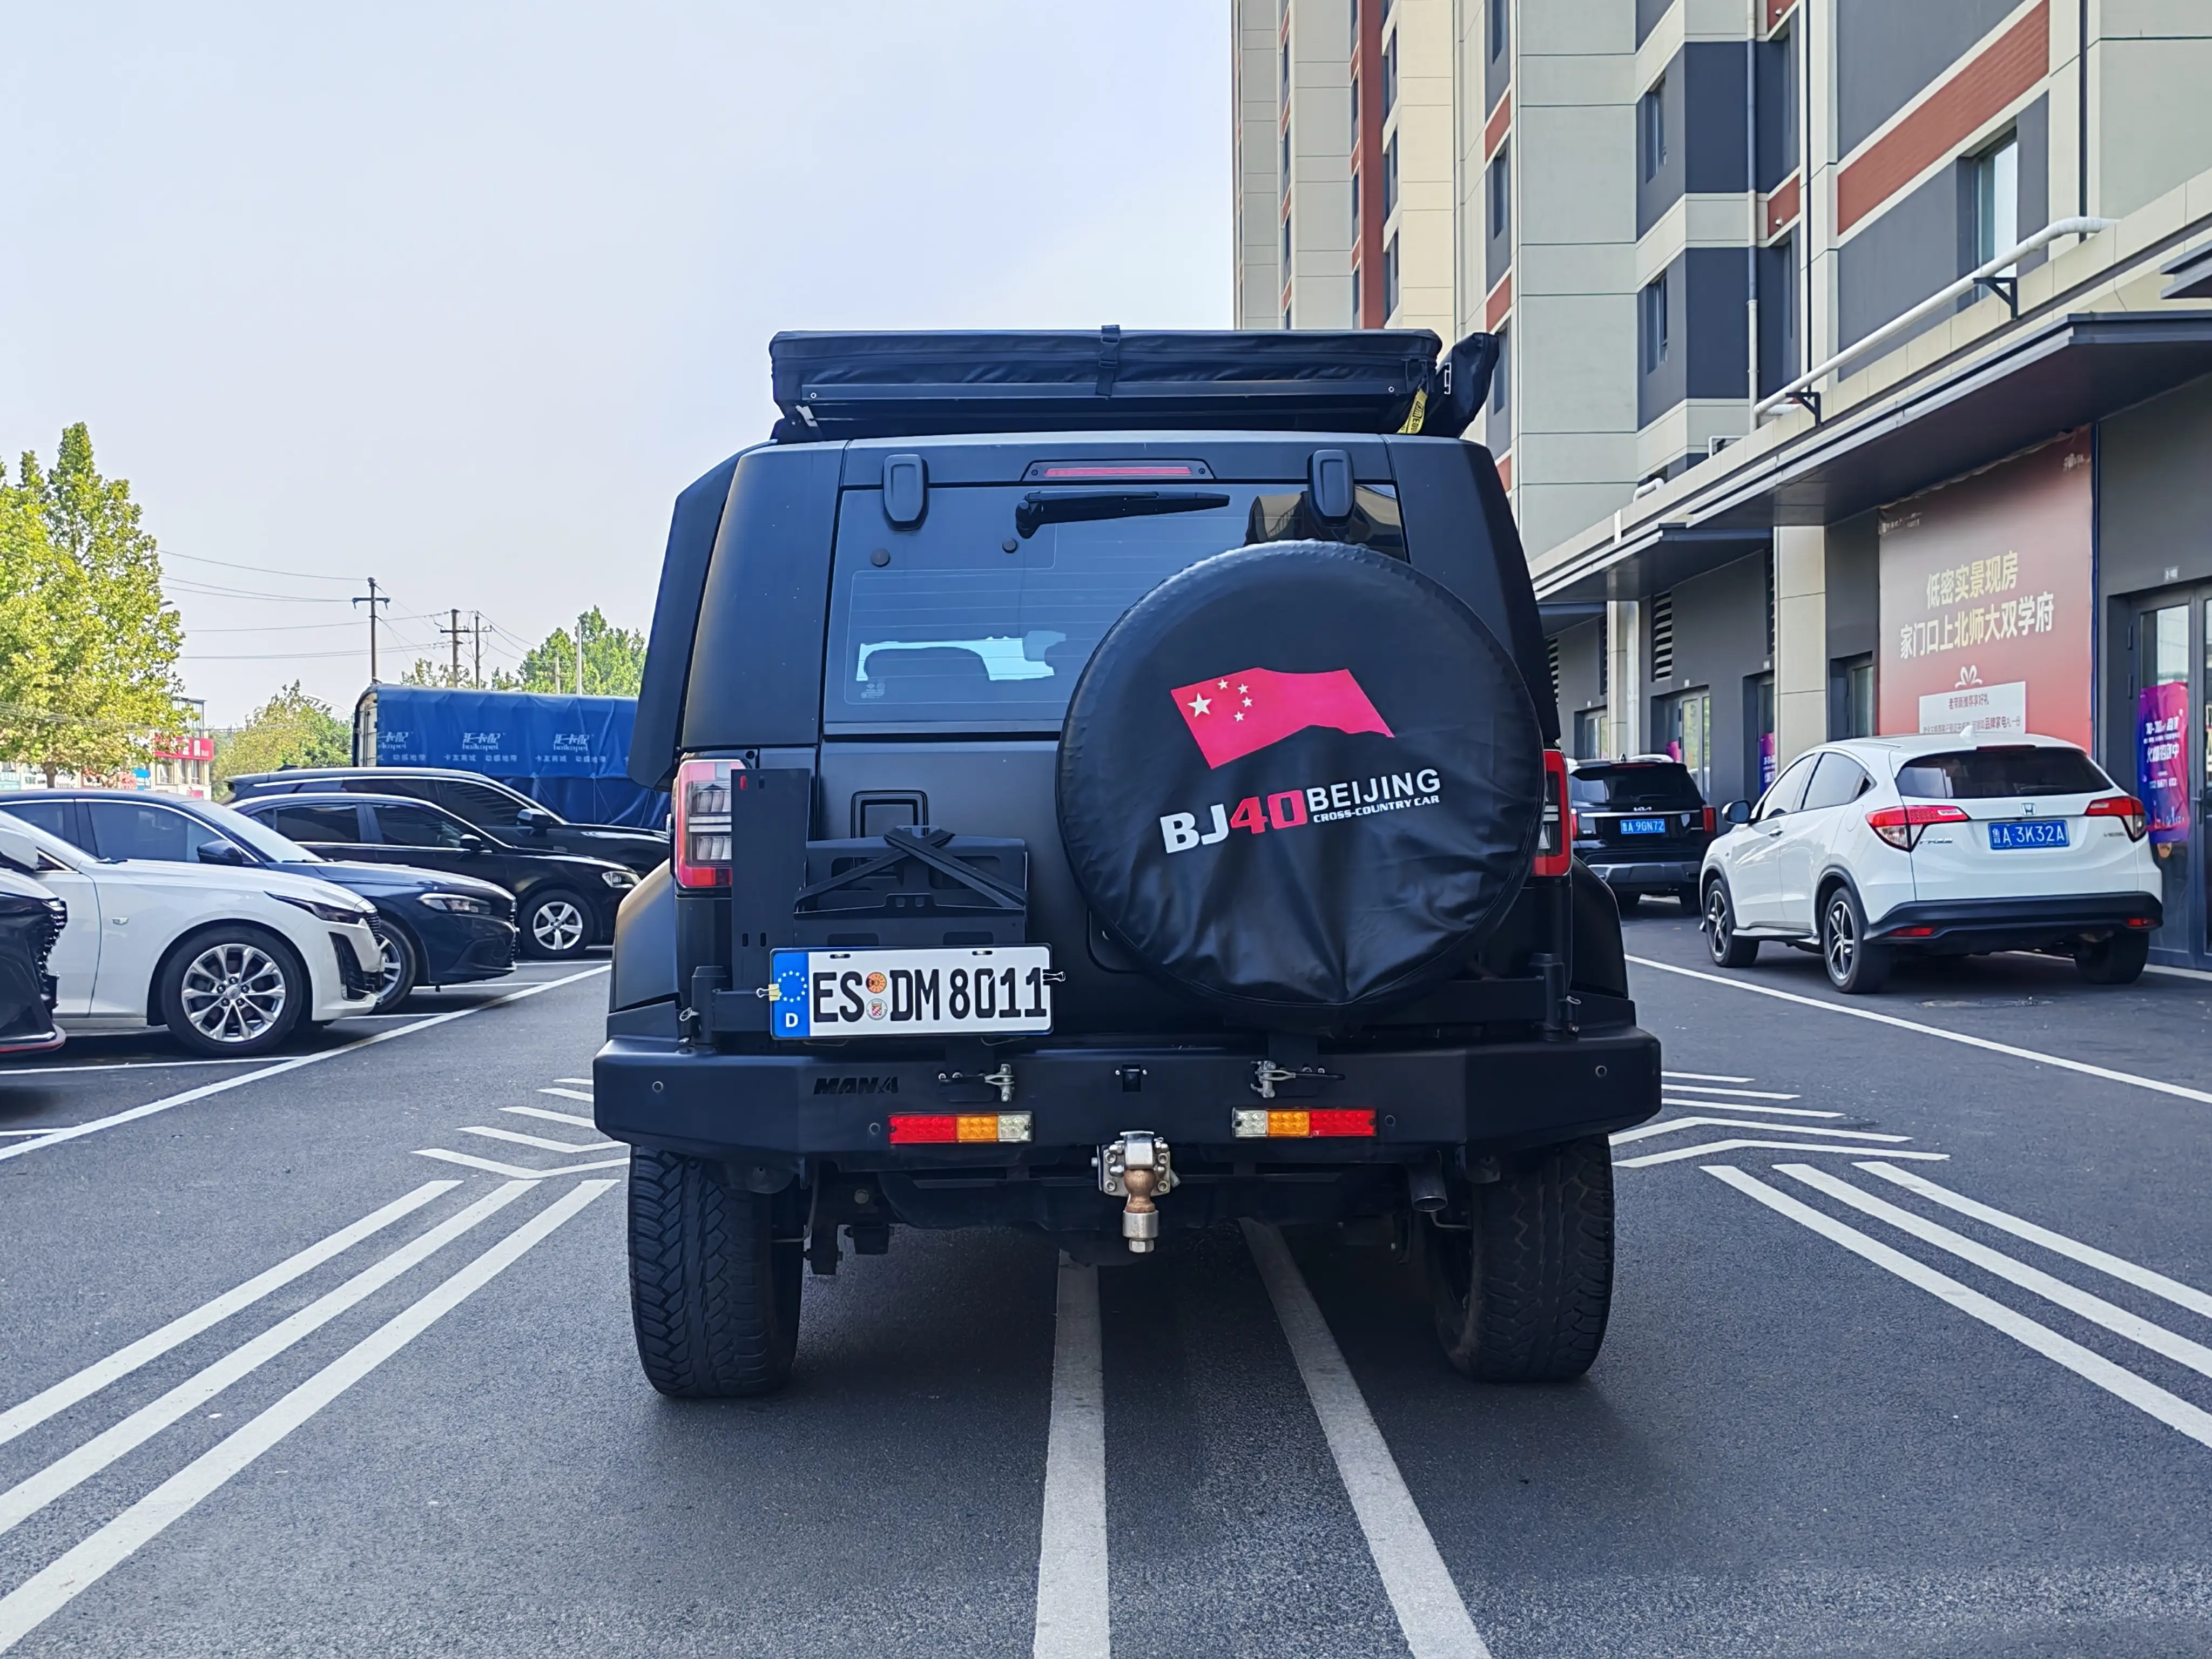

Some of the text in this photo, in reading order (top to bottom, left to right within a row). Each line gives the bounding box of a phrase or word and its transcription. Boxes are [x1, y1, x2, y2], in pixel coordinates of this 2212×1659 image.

[1927, 550, 2018, 609] 低密实景现房
[1900, 591, 2054, 659] 家门口上北师大双学府
[1306, 769, 1441, 812] BEIJING
[1313, 794, 1440, 823] CROSS-COUNTRY CAR
[1160, 790, 1308, 853] BJ40
[785, 1013, 799, 1027] D
[813, 971, 864, 1022] ES
[889, 969, 940, 1021] DM
[949, 967, 1047, 1020] 8011
